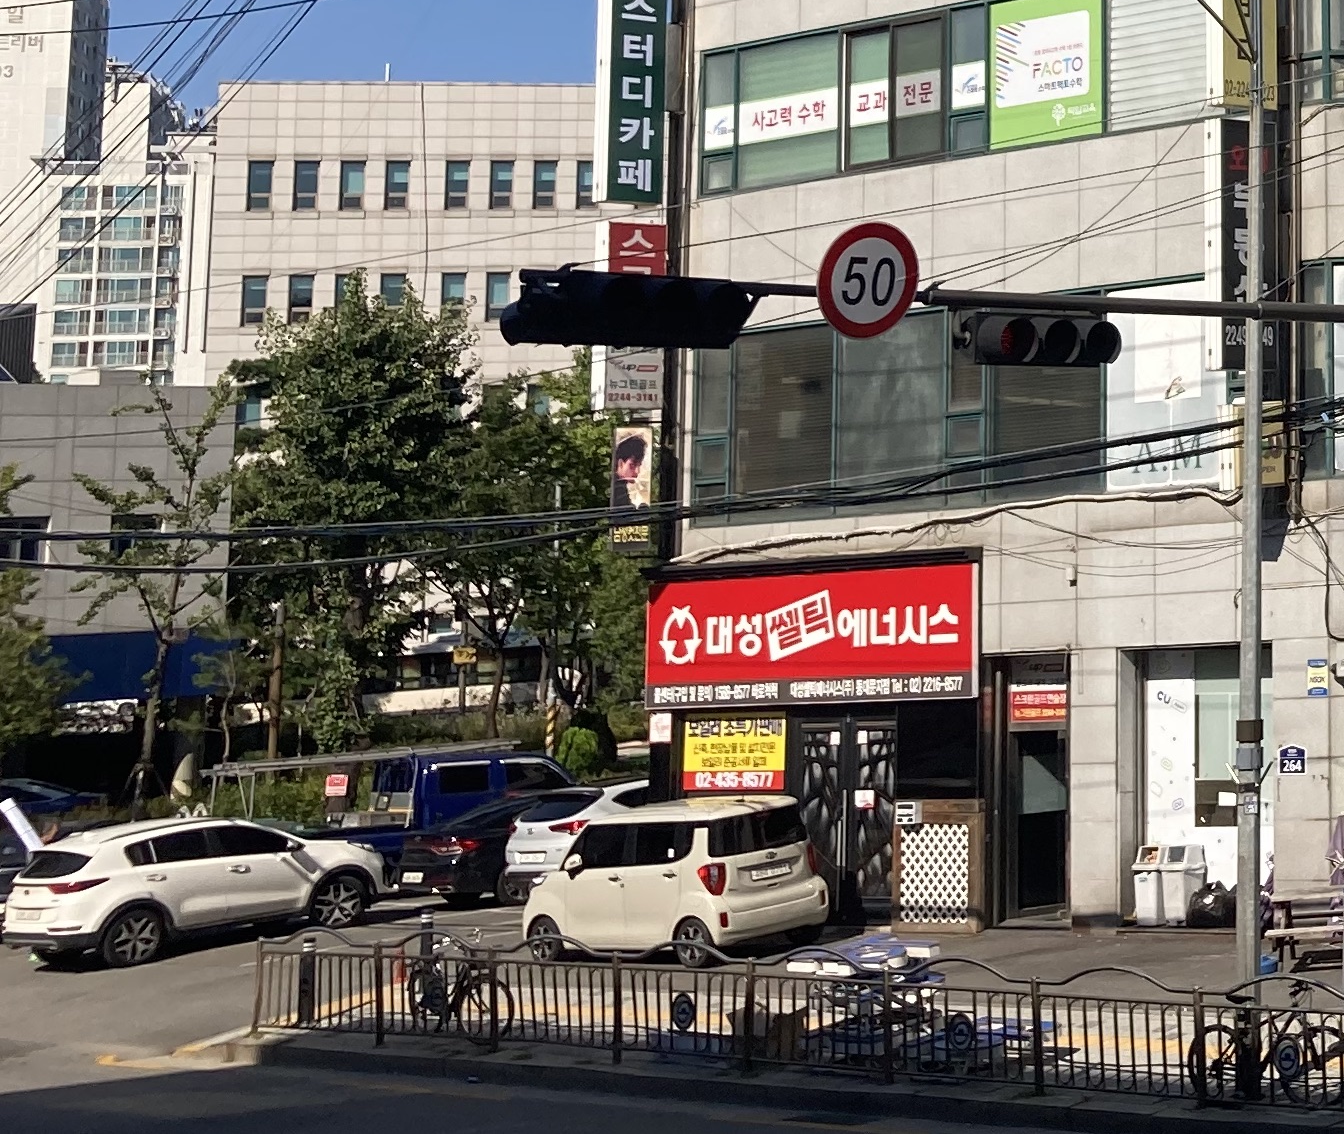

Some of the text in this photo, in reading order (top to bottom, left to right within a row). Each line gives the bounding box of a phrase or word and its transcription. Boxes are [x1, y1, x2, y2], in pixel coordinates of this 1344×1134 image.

[1033, 57, 1083, 79] FACTO
[856, 81, 934, 114] 교과 전문
[751, 98, 827, 129] 사고력 수학
[842, 256, 897, 307] 50
[609, 379, 658, 391] 뉴그린골프
[909, 676, 922, 694] 02)
[1282, 759, 1303, 772] 264
[695, 771, 774, 788] 02-435-8577
